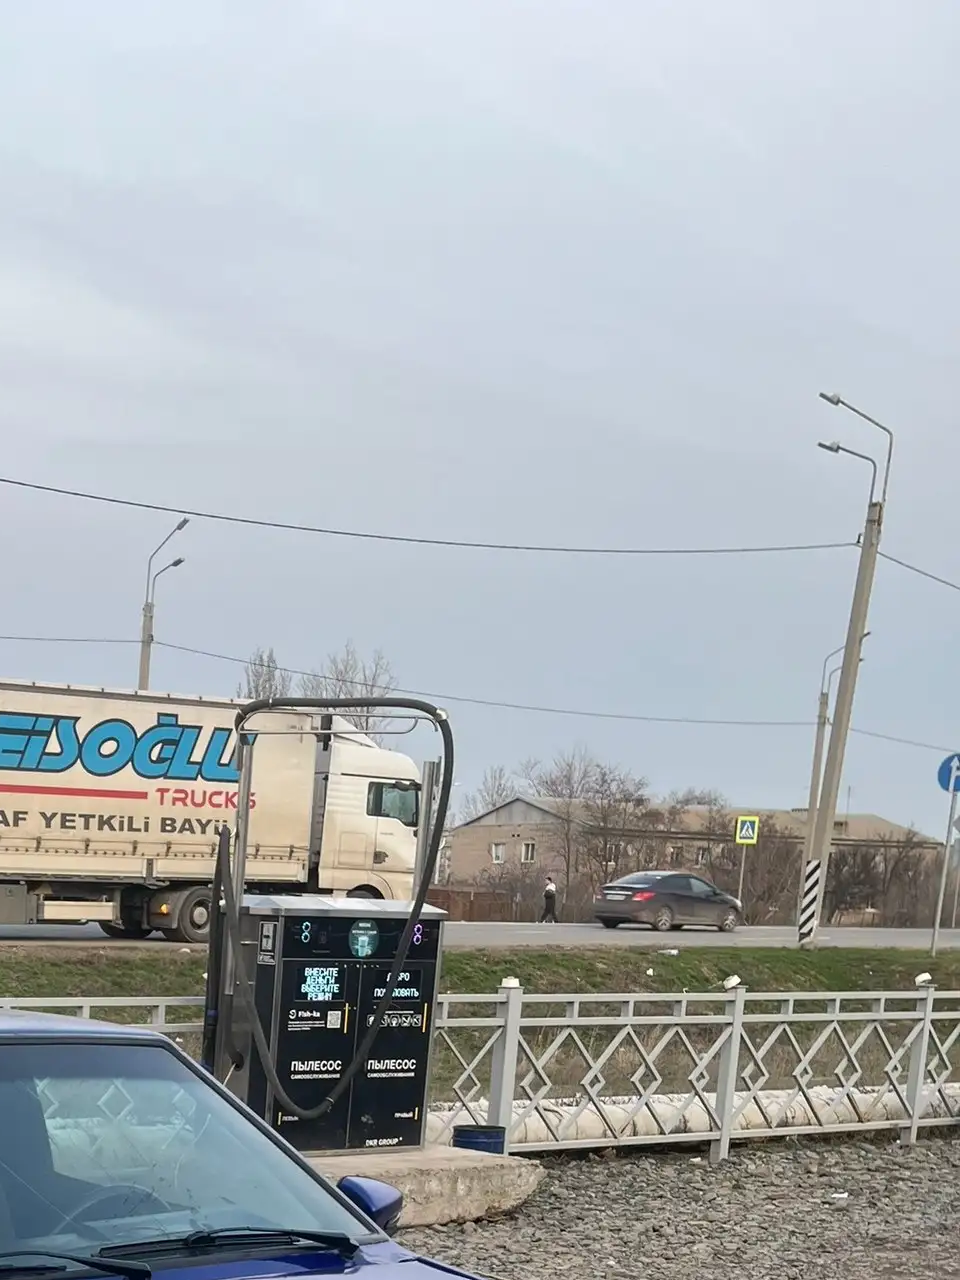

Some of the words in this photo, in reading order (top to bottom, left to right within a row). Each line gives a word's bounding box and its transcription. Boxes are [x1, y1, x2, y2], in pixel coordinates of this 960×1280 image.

[304, 967, 339, 976] ВНЕСИТЕ
[305, 976, 335, 985] ДЕНЬГИ
[301, 984, 340, 993] ВЫБЕРИТЕ
[291, 1060, 342, 1071] ПЫЛЕСОС
[367, 1059, 417, 1070] ПЫЛЕСОС
